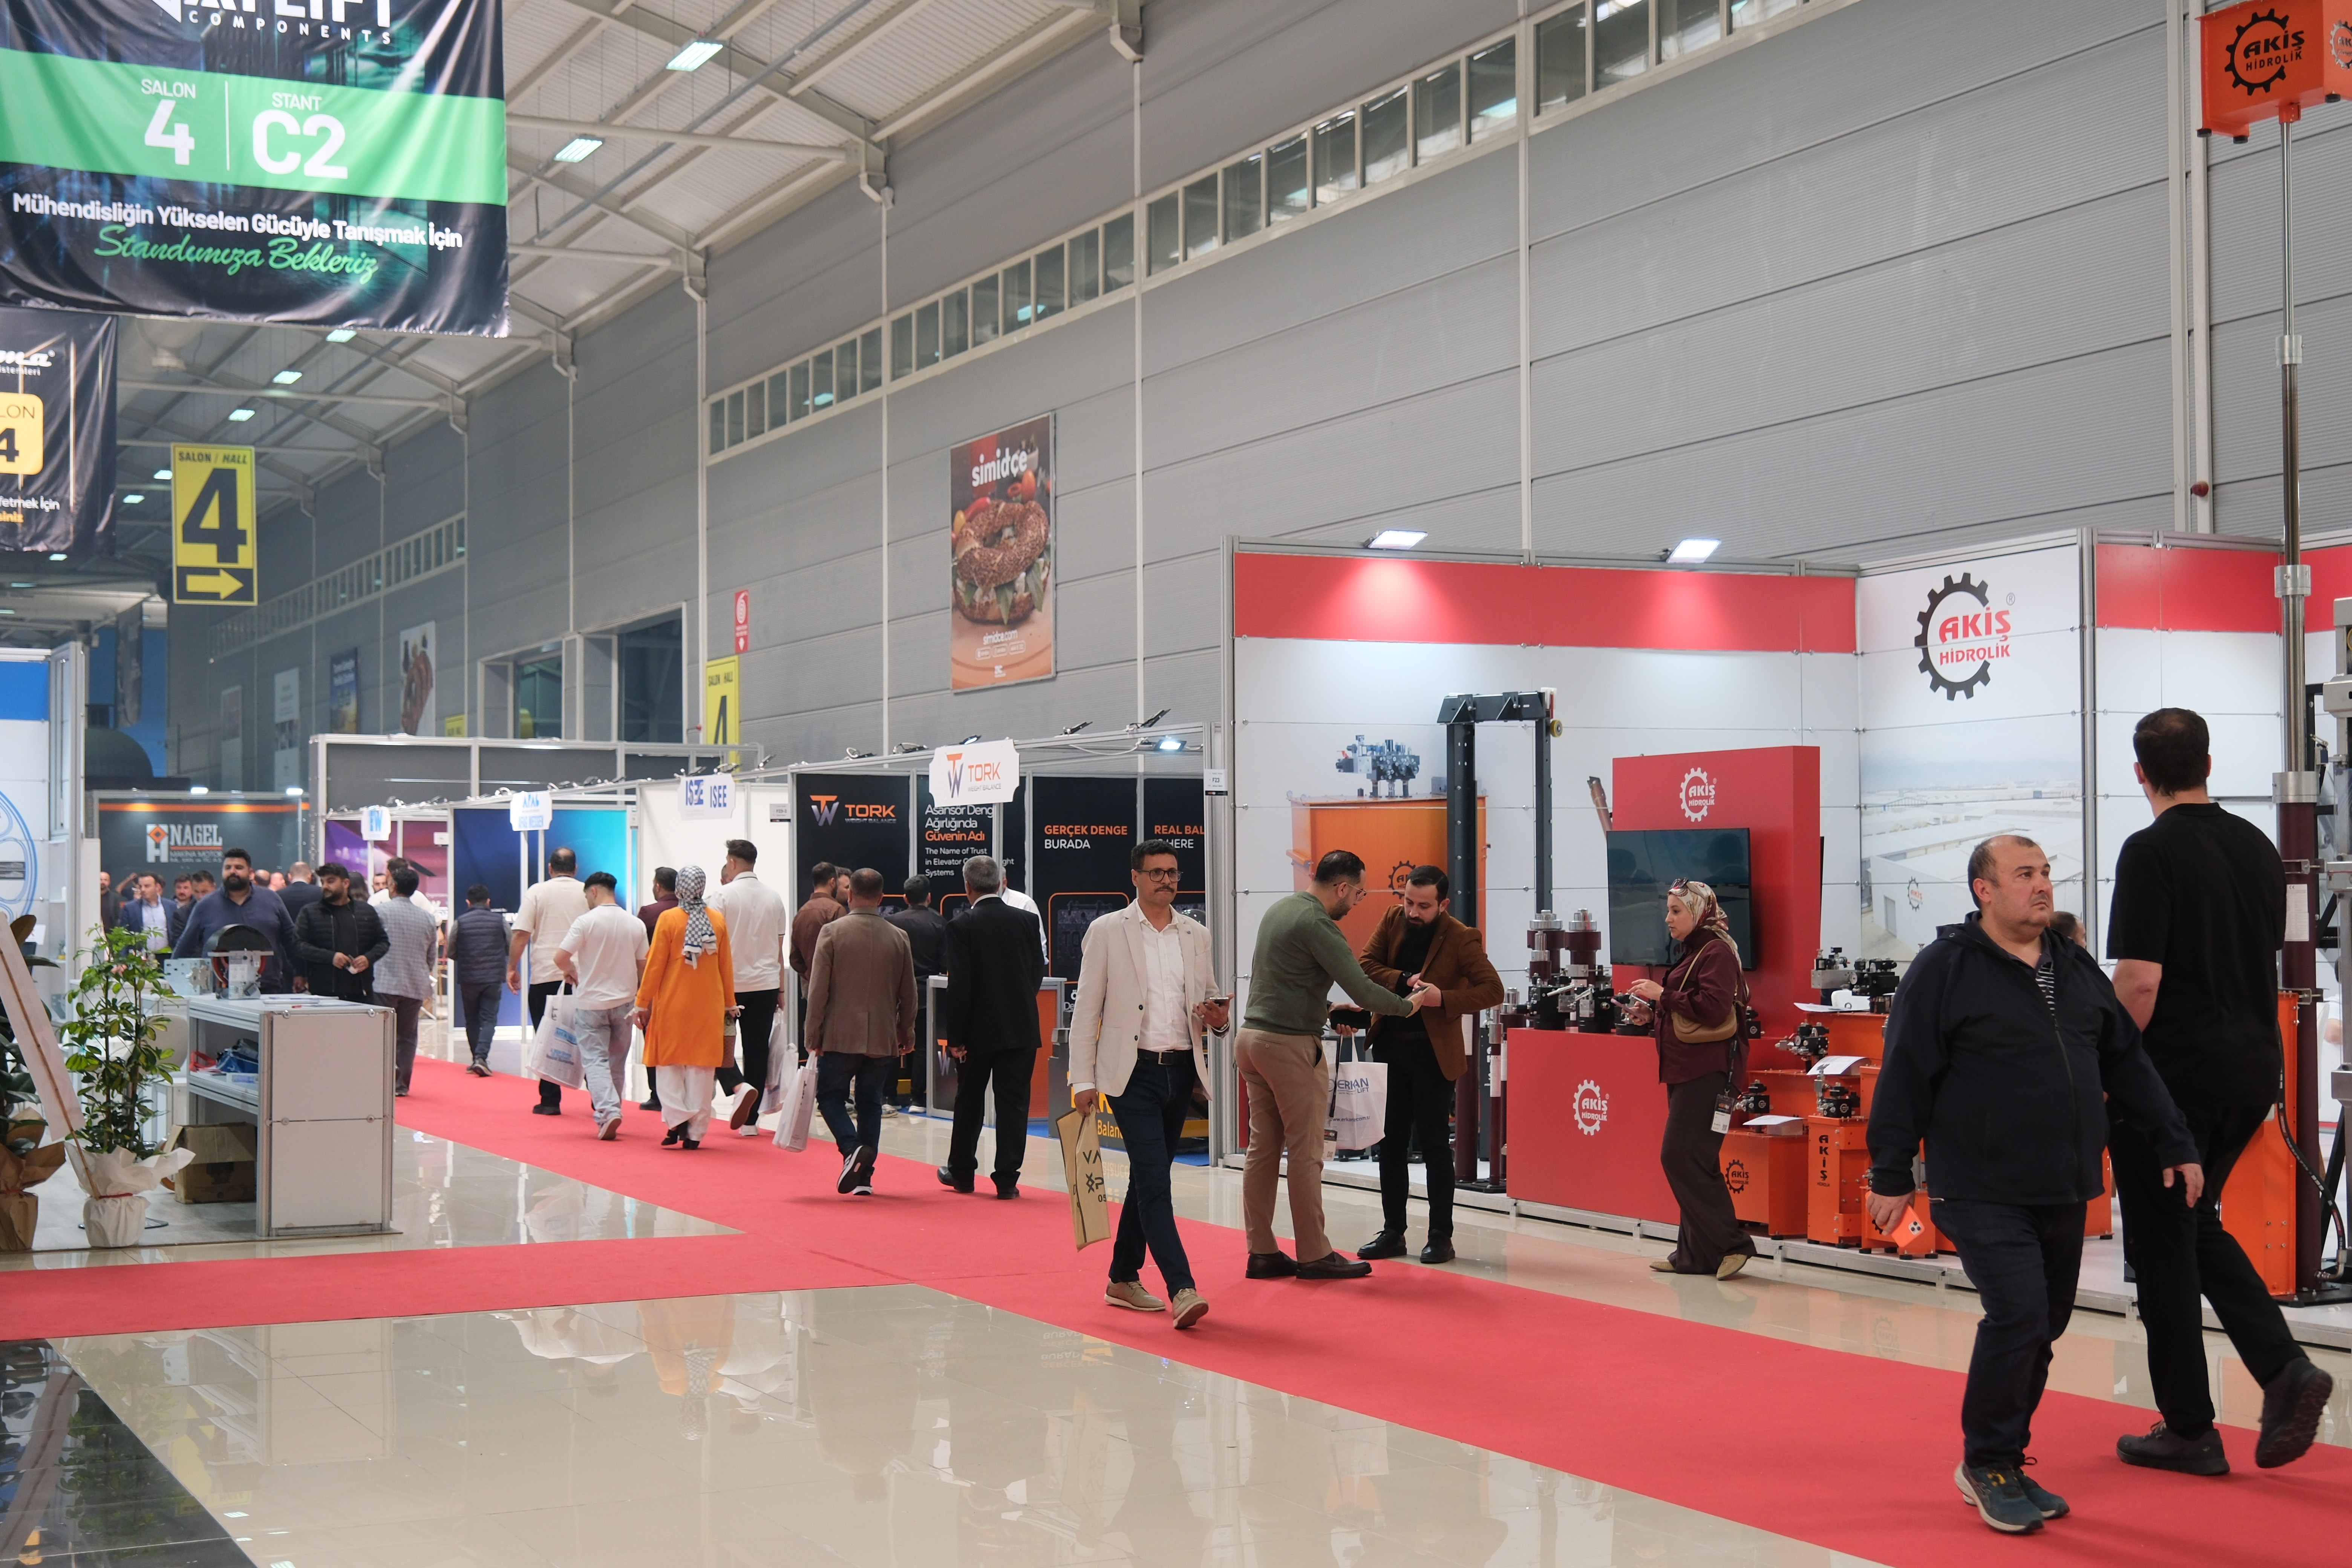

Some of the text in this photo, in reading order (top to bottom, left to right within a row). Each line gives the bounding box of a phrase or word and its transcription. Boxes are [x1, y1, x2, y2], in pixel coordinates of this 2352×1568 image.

[188, 10, 391, 44] COMPONENTS
[2243, 30, 2305, 59] AKİŞ
[2246, 50, 2302, 71] HİDROLİK
[141, 79, 196, 99] SALON
[272, 92, 322, 112] STANT
[144, 99, 195, 165] 4
[252, 110, 348, 179] C2
[13, 193, 463, 250] Mühendisliğin Yükselen Gücüyle Tanışmak İçin
[268, 237, 378, 285] Bekleriz
[179, 453, 247, 464] SALON HALL
[182, 468, 247, 563] 4
[1939, 607, 2011, 644] AKİŞ
[1939, 643, 2011, 666] HİDROLİK
[968, 762, 1001, 782] TORK
[1689, 783, 1715, 799] AKİŞ
[845, 804, 896, 818] TORK
[925, 804, 993, 818] Asansör Deng
[1689, 798, 1715, 807] HİDROLİK
[170, 824, 223, 846] NAGEL
[925, 830, 967, 841] Güvenin
[1044, 825, 1128, 837] GERÇEK DENGE
[1154, 825, 1205, 835] REAL BAL
[1044, 839, 1091, 849] BURADA
[925, 868, 955, 878] Systems
[1337, 1078, 1369, 1090] ERKAN
[1582, 1097, 1608, 1115] AKİŞ
[1582, 1111, 1607, 1121] HİDROLİK
[1731, 1170, 1749, 1180] AKİŞ
